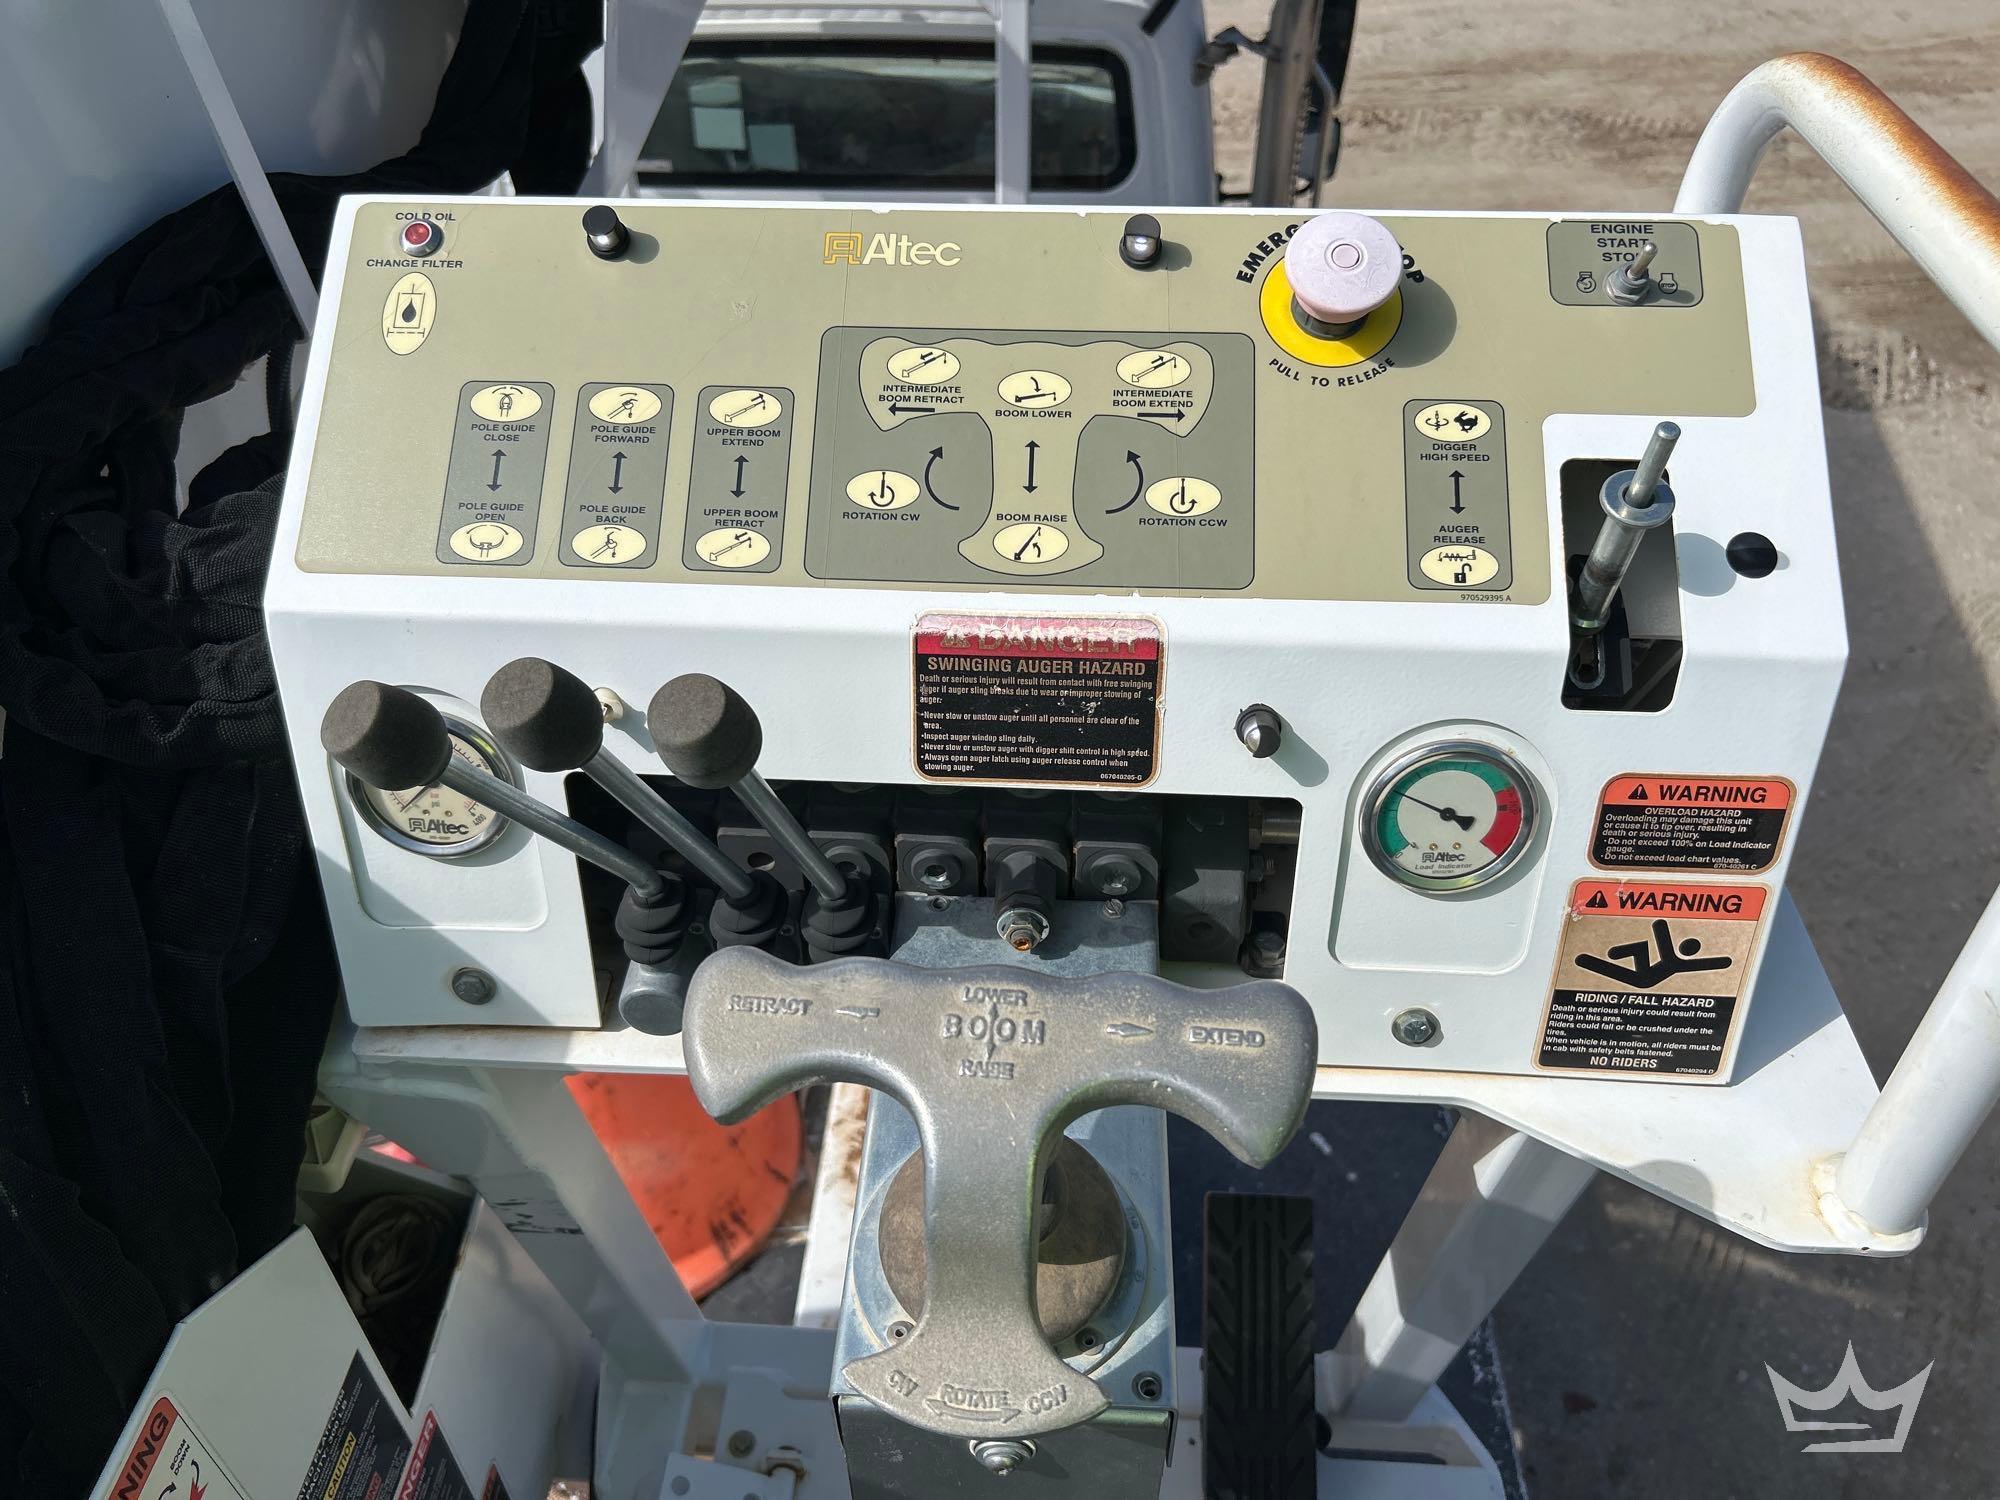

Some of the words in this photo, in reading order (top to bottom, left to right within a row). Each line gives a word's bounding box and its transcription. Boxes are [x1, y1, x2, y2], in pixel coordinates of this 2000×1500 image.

[395, 212, 432, 221] COLD
[435, 213, 455, 221] OIL
[1591, 224, 1653, 234] ENGINE
[1597, 238, 1649, 248] START
[863, 232, 961, 268] Altec
[1236, 221, 1313, 284] EMERG
[1602, 252, 1639, 262] STO
[367, 259, 418, 268] CHANGE
[422, 260, 463, 269] FILTER
[1269, 358, 1300, 381] PULL
[1311, 376, 1330, 387] TO
[1338, 357, 1395, 387] RELEASE
[883, 385, 961, 394] INTERMEDIATE
[1113, 389, 1192, 398] INTERMEDIATE
[879, 394, 911, 403] BOOM
[914, 395, 964, 404] RETRACT
[1113, 399, 1146, 407] BOOM
[1150, 399, 1193, 408] EXTEND
[995, 409, 1029, 418] BOOM
[1032, 409, 1072, 418] LOWER
[471, 424, 498, 433] POLE
[502, 424, 536, 434] GUIDE
[590, 425, 618, 435] POLE
[622, 426, 656, 435] GUIDE
[707, 428, 745, 438] UPPER
[748, 428, 781, 438] BOOM
[483, 433, 520, 443] CLOSE
[595, 435, 650, 444] FORWARD
[722, 438, 765, 447] EXTEND
[1420, 453, 1448, 461] HIGH
[458, 502, 486, 511] POLE
[490, 503, 524, 512] GUIDE
[580, 505, 608, 514] POLE
[611, 505, 646, 515] GUIDE
[475, 512, 506, 521] OPEN
[704, 508, 741, 518] UPPER
[745, 509, 778, 519] BOOM
[842, 512, 898, 521] ROTATION
[901, 513, 920, 521] CW
[996, 513, 1031, 522] BOOM
[1034, 514, 1068, 523] RAISE
[596, 515, 627, 524] BACK
[715, 519, 765, 528] RETRACT
[1139, 518, 1196, 527] ROTATION
[1200, 518, 1227, 527] CCW
[1461, 594, 1503, 602] 970529395
[927, 656, 1012, 673] SWINGING
[1016, 659, 1073, 674] AUGER
[1079, 661, 1146, 676] HAZARD
[920, 674, 940, 682] Death
[951, 675, 977, 683] serious
[980, 676, 999, 686] injury
[1002, 676, 1015, 684] will
[1017, 677, 1039, 685] result
[1040, 678, 1056, 686] from
[1059, 678, 1084, 687] contact
[1087, 679, 1101, 687] with
[1104, 679, 1119, 688] free
[1120, 680, 1152, 689] swinging
[1659, 784, 1767, 803] WARNING
[1645, 807, 1699, 816] OVERLOAD
[1701, 808, 1741, 817] HAZARD
[1605, 814, 1658, 823] Overloading
[1659, 816, 1678, 825] may
[1680, 816, 1715, 825] damage
[1716, 817, 1732, 825] this
[1735, 817, 1752, 825] unit
[427, 819, 469, 834] Altec
[1642, 822, 1649, 830] it
[1662, 823, 1673, 832] tip
[1697, 824, 1736, 834] resulting
[1738, 825, 1747, 833] in
[1602, 829, 1626, 837] death
[1639, 830, 1672, 838] serious
[1674, 831, 1700, 840] injury.
[1622, 838, 1636, 846] not
[1638, 838, 1668, 846] exceed
[1709, 841, 1731, 849] Load
[1732, 841, 1771, 849] Indicator
[1606, 846, 1635, 855] gauge.
[1435, 852, 1466, 862] Altec
[1635, 854, 1665, 862] exceed
[1687, 855, 1710, 863] chart
[1712, 856, 1741, 864] values.
[1619, 890, 1743, 913] WARNING
[963, 986, 1028, 1007] LOWER
[1575, 993, 1619, 1003] RIDING
[1628, 995, 1658, 1005] FALL
[1662, 996, 1714, 1008] HAZARD
[728, 995, 813, 1015] RETRACT
[1552, 1004, 1576, 1012] Death
[1578, 1005, 1587, 1013] or
[1589, 1005, 1619, 1014] serious
[1620, 1007, 1644, 1016] injury
[1646, 1008, 1669, 1016] could
[1671, 1009, 1695, 1017] result
[1697, 1010, 1716, 1018] from
[942, 1013, 1045, 1045] BOOM
[1547, 1028, 1566, 1036] tires.
[1548, 1020, 1575, 1028] Riders
[1577, 1021, 1600, 1029] could
[1627, 1024, 1637, 1032] be
[1639, 1024, 1671, 1033] crushed
[1673, 1026, 1698, 1034] under
[1700, 1027, 1713, 1035] the
[1188, 1024, 1266, 1049] EXTEND
[1545, 1036, 1567, 1044] When
[1569, 1037, 1599, 1045] vehicle
[1600, 1038, 1607, 1046] is
[1652, 1040, 1662, 1049] all
[1664, 1041, 1687, 1050] riders
[1690, 1043, 1709, 1051] must
[1711, 1043, 1721, 1051] be
[1590, 1056, 1607, 1067] NO
[1612, 1057, 1658, 1068] RIDERS
[959, 1059, 1015, 1080] RAISE
[887, 1369, 918, 1398] CW
[940, 1384, 1012, 1410] ROTATE
[1025, 1384, 1068, 1415] CCW
[170, 1438, 186, 1470] BOOM
[174, 1444, 190, 1476] DOWN
[328, 1435, 355, 1499] CAUTION
